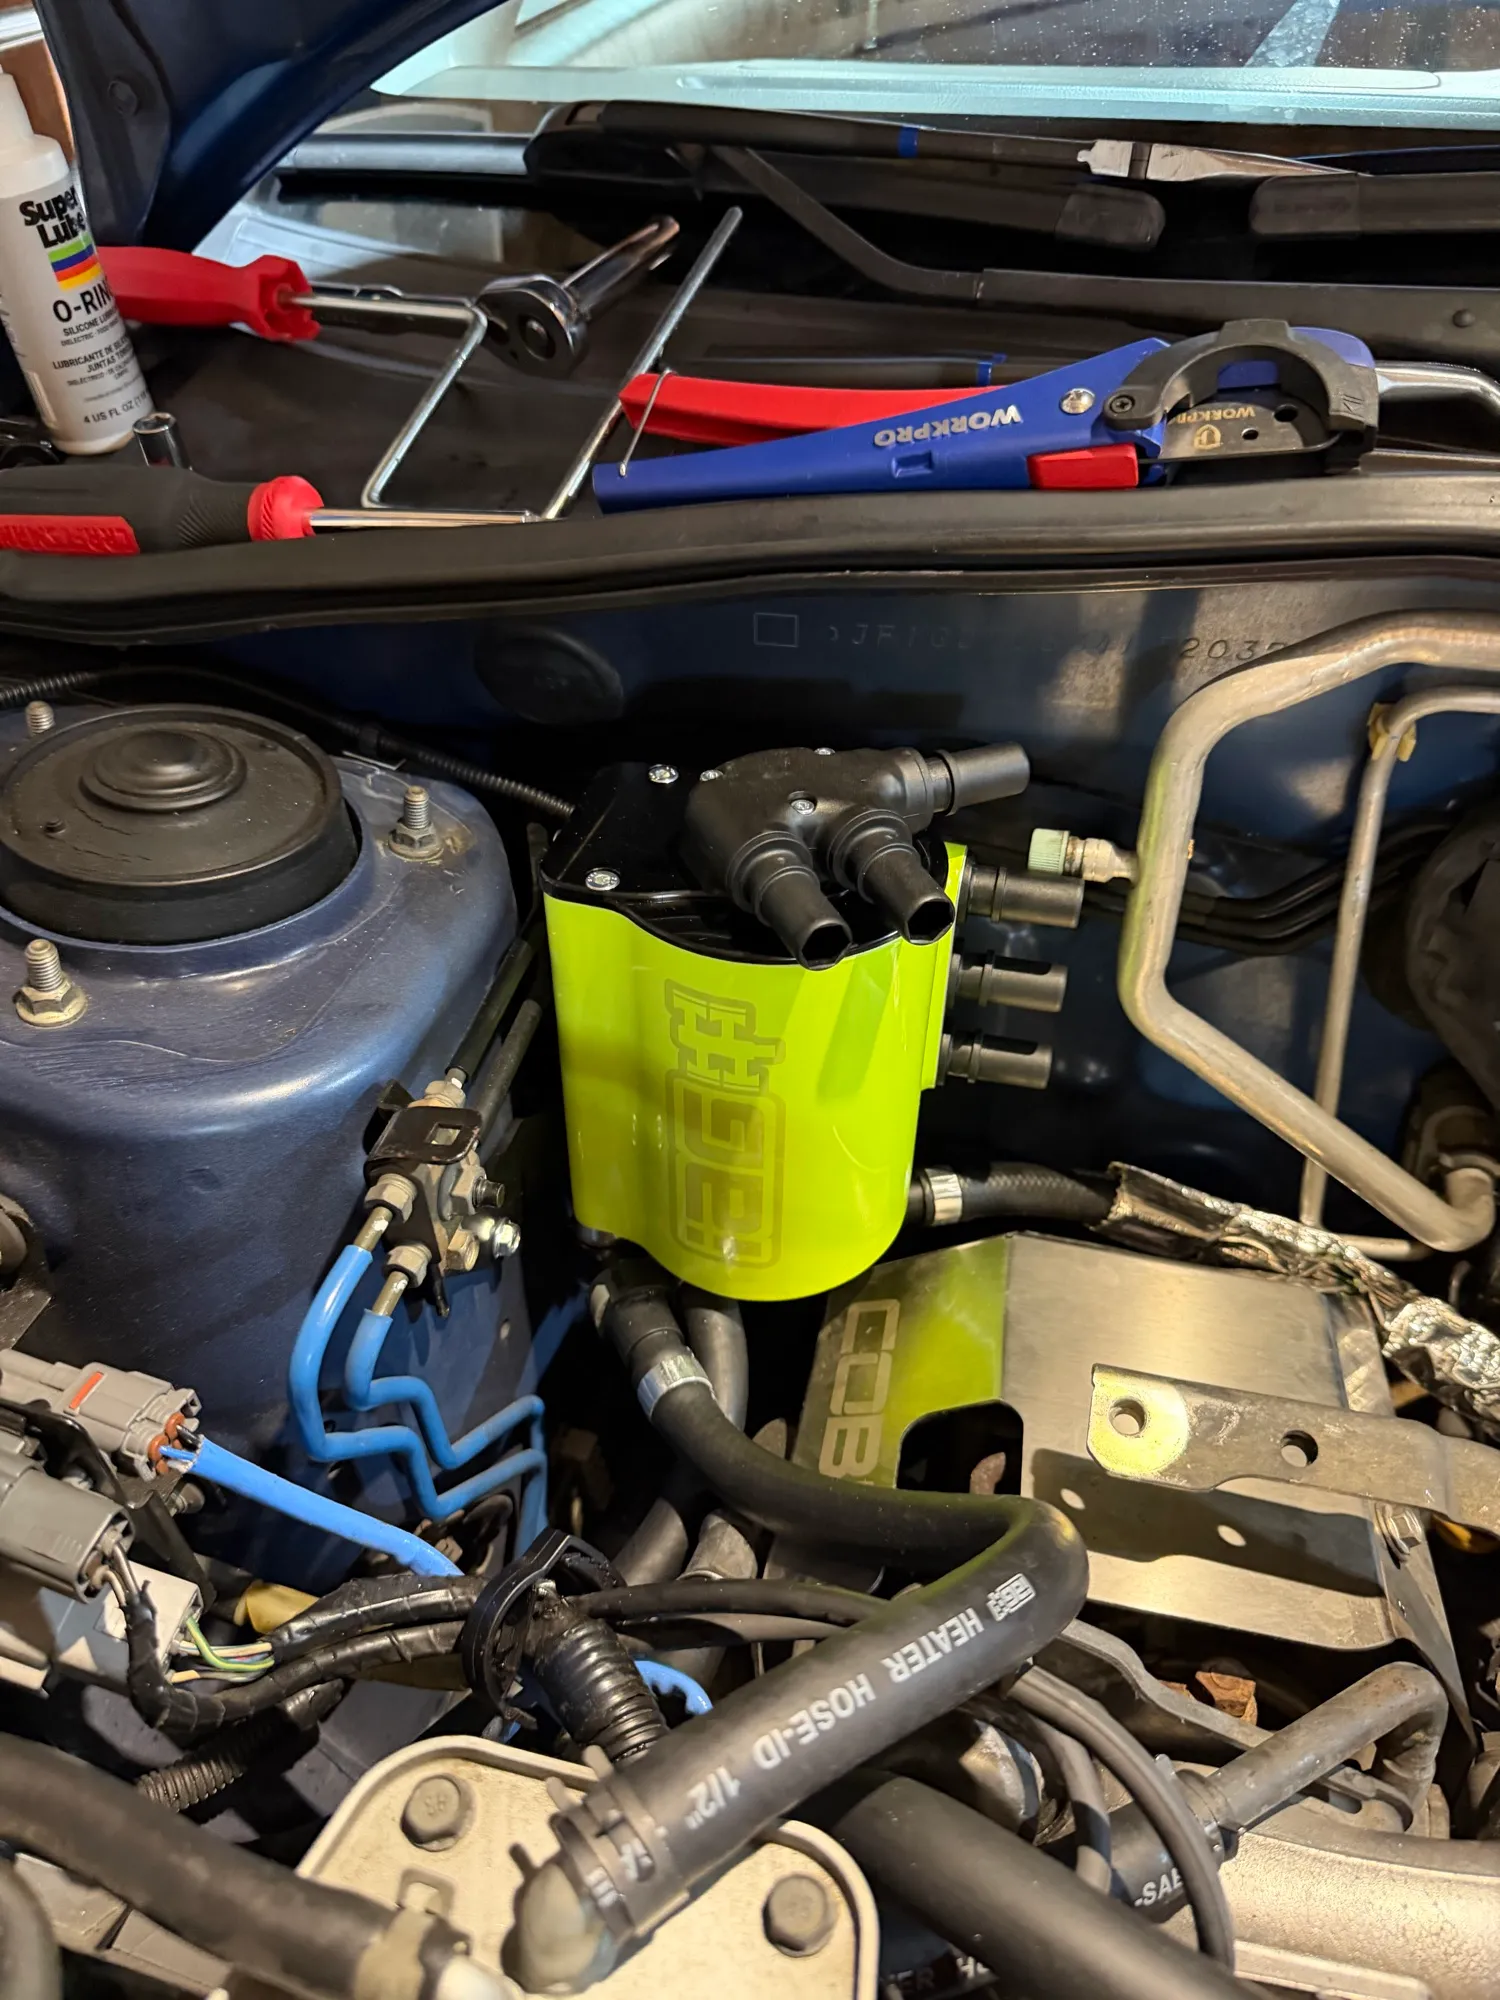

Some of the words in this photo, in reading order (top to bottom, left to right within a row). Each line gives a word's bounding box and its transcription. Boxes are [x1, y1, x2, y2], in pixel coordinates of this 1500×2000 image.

[19, 185, 78, 226] Super
[36, 212, 86, 249] Lube
[53, 276, 114, 323] O-RIN
[63, 317, 98, 337] SILICONE
[52, 349, 104, 370] LUBRICANTE
[87, 354, 117, 373] JUNTAS
[92, 411, 108, 423] US
[108, 407, 121, 419] FL
[122, 400, 135, 412] OZ
[874, 404, 1023, 447] WORKPRO
[819, 1298, 900, 1484] COB
[880, 1607, 985, 1683] HEATER
[752, 1673, 877, 1769] HOSE-ID
[684, 1766, 741, 1829] 1/2"
